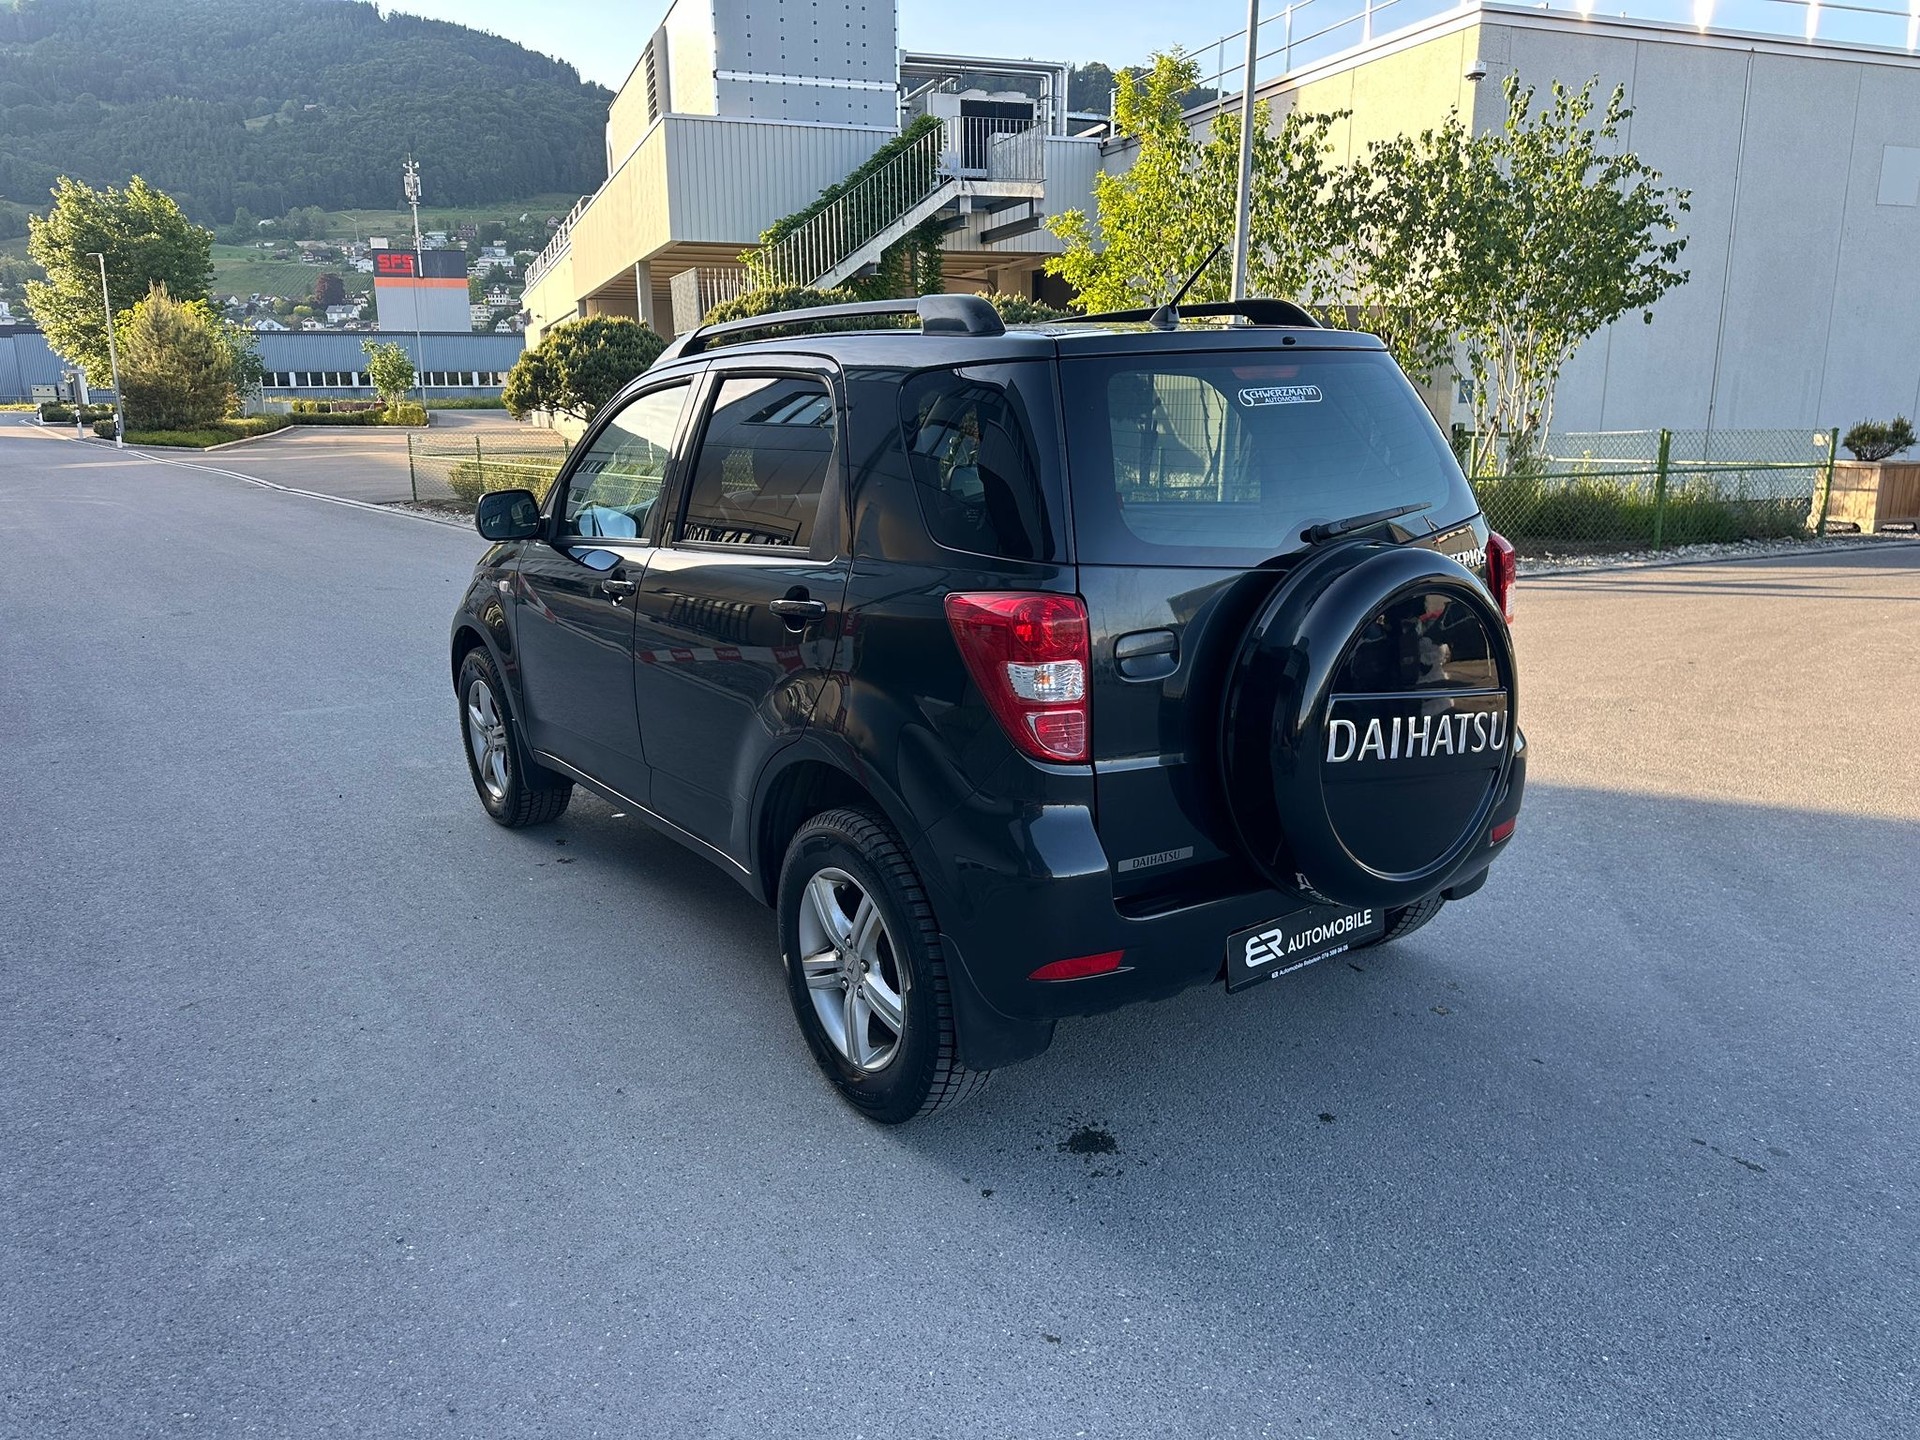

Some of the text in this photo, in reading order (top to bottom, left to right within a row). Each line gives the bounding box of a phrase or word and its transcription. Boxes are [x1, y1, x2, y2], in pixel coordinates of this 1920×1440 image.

[377, 254, 414, 270] SFS
[1242, 387, 1317, 407] SCHWERZMANN
[1264, 395, 1306, 404] AUTOMOBILE
[1326, 710, 1508, 763] DAIHATSU
[1132, 850, 1181, 869] DAIHATSU
[1287, 908, 1372, 954] AUTOMOBILE
